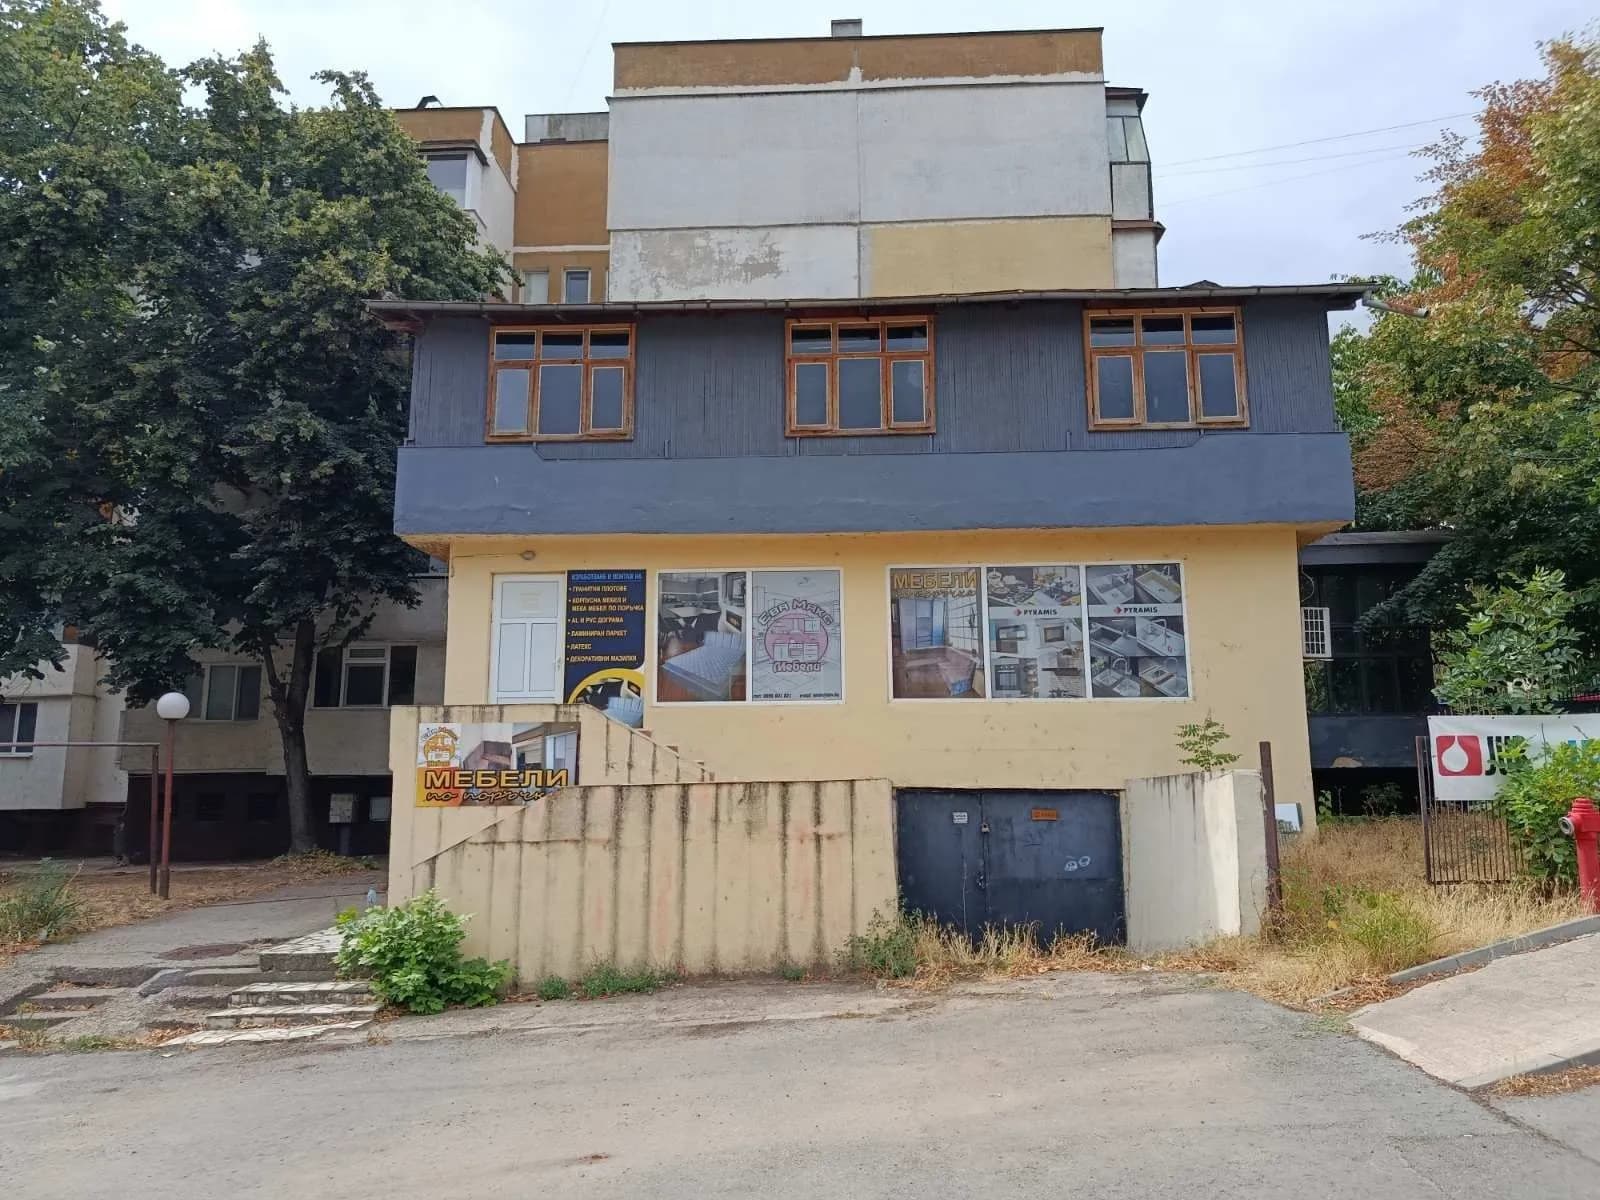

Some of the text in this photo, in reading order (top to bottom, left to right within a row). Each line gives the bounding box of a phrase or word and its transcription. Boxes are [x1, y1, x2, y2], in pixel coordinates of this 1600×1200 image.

[894, 572, 977, 589] МЕБЕЛИ
[425, 769, 568, 788] МЕБЕЛИ
[426, 790, 545, 804] по поръчк
